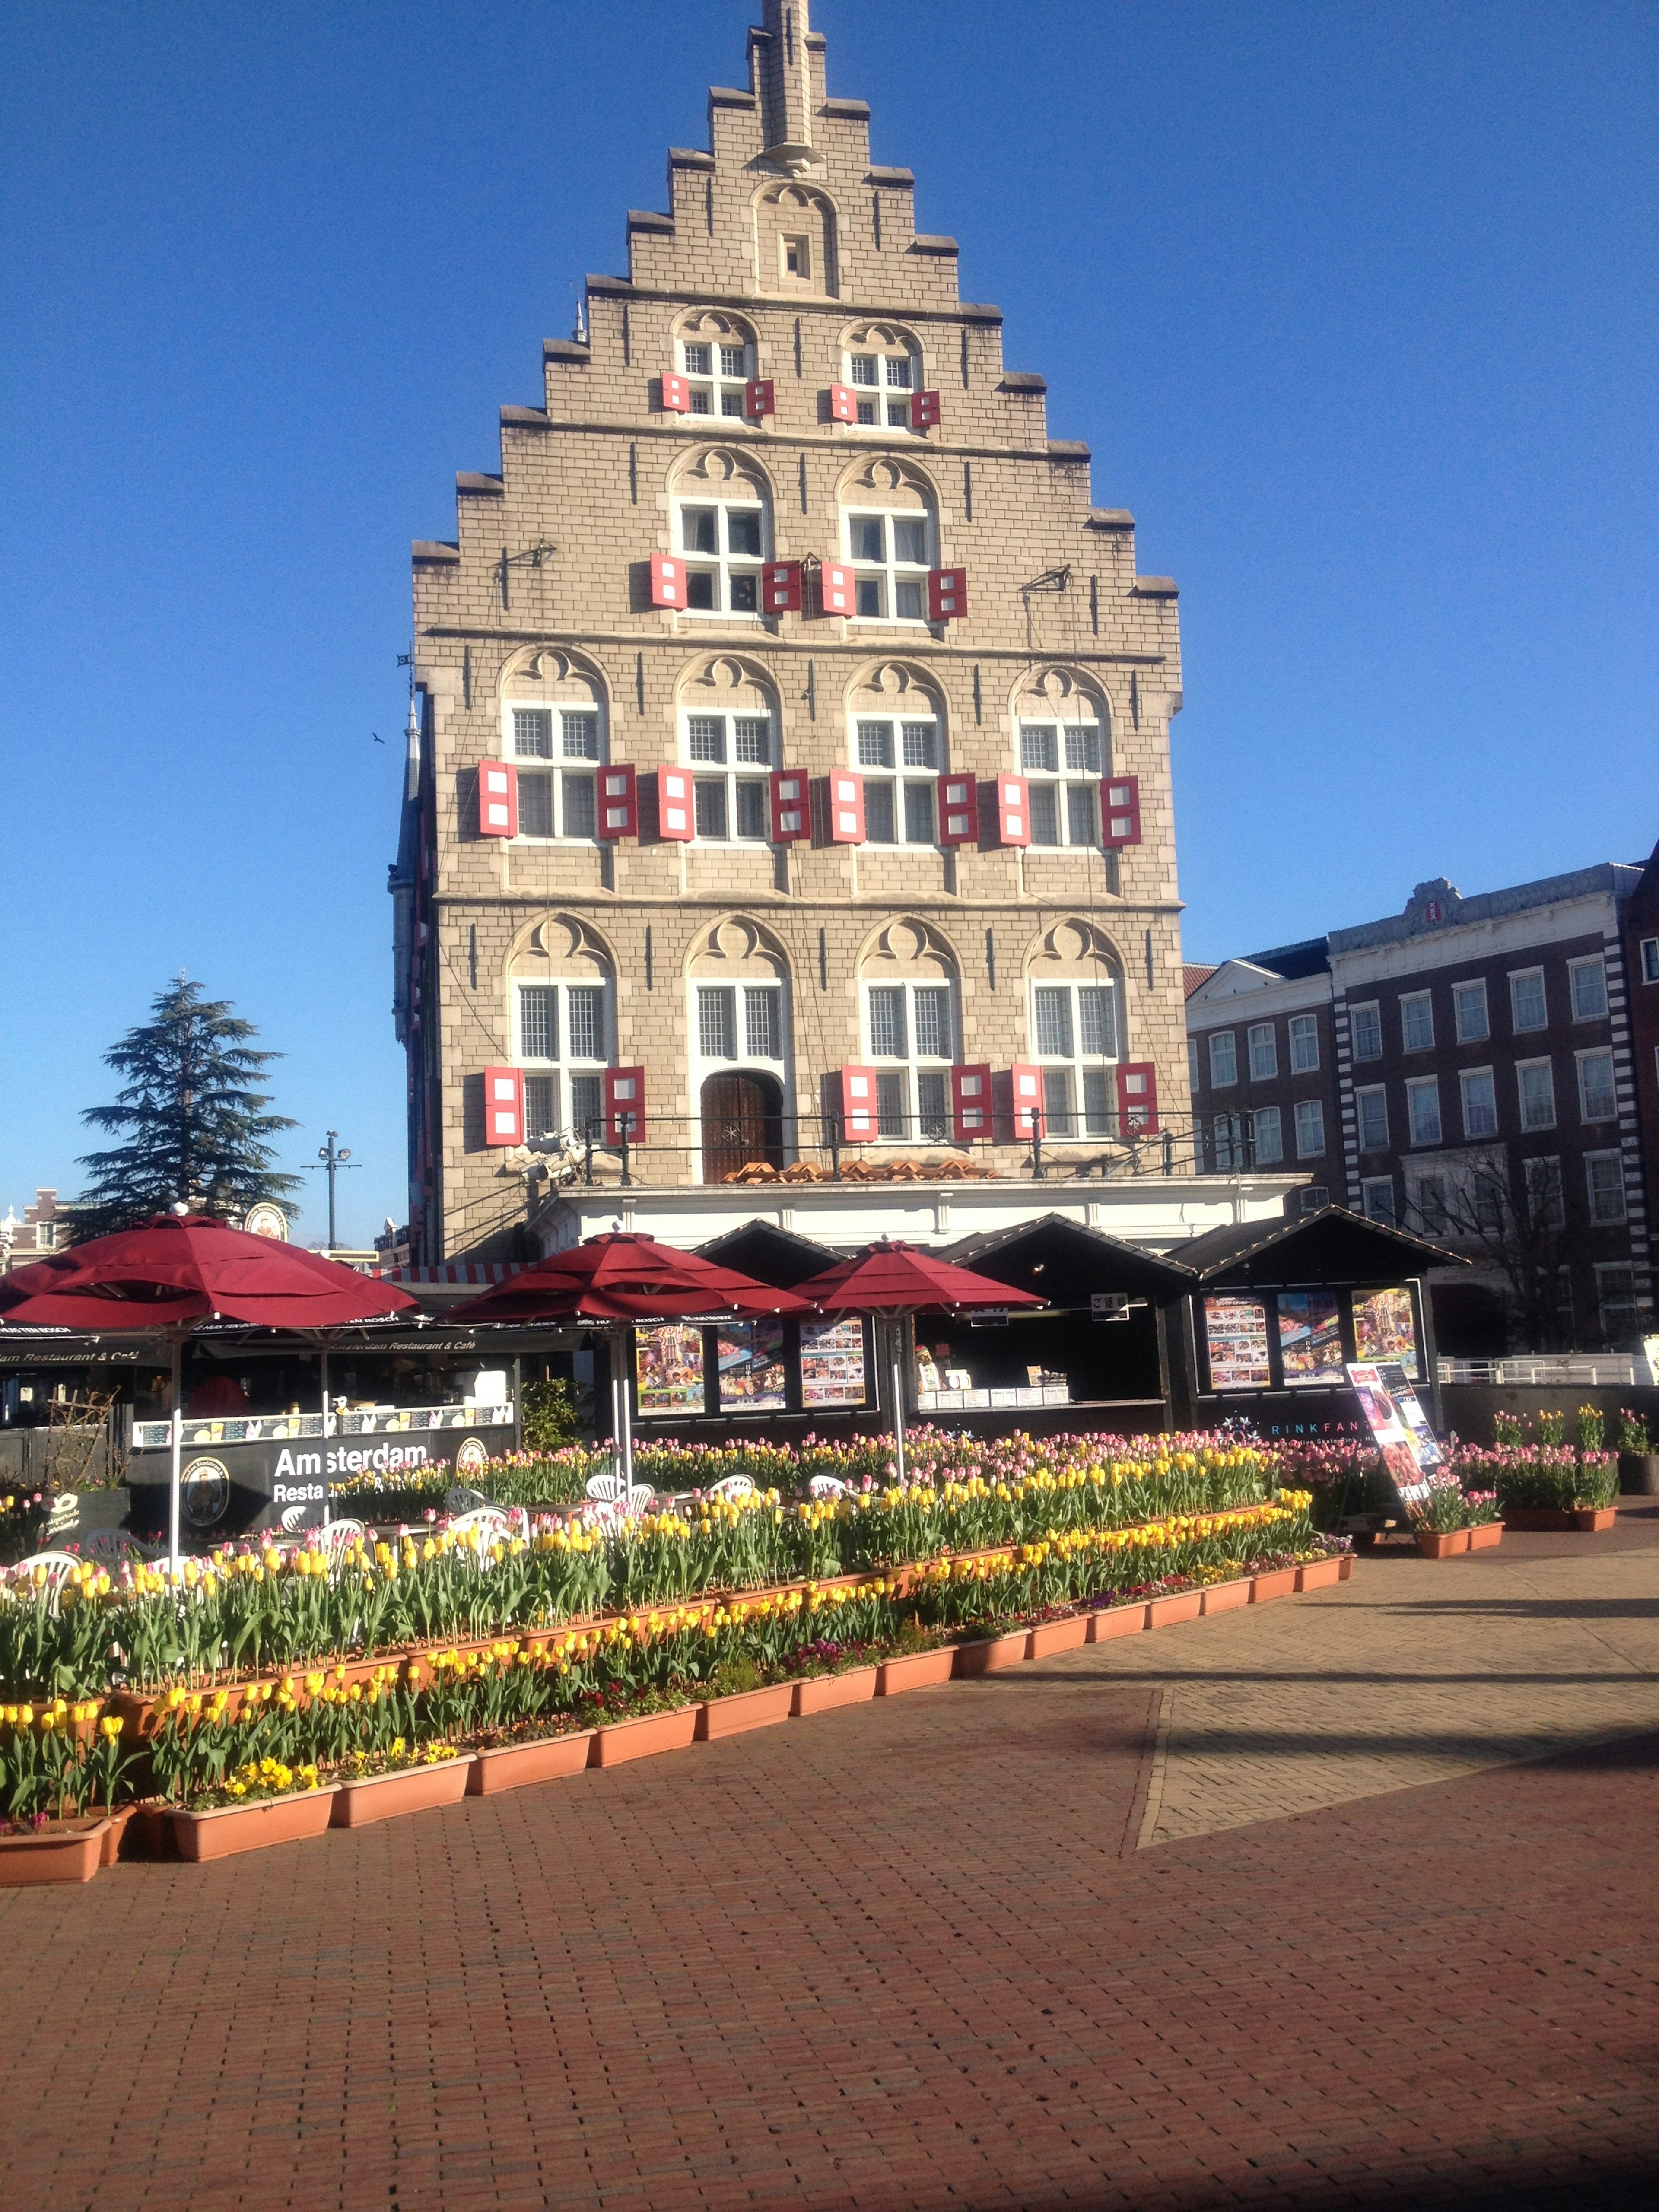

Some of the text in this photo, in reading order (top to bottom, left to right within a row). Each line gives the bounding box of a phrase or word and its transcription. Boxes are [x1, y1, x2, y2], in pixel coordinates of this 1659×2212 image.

[388, 1341, 443, 1350] Restaurant
[444, 1341, 452, 1349] &
[453, 1341, 476, 1349] Café
[23, 1353, 96, 1361] Restaurant
[98, 1352, 108, 1361] &
[274, 1442, 427, 1477] Amsterdam
